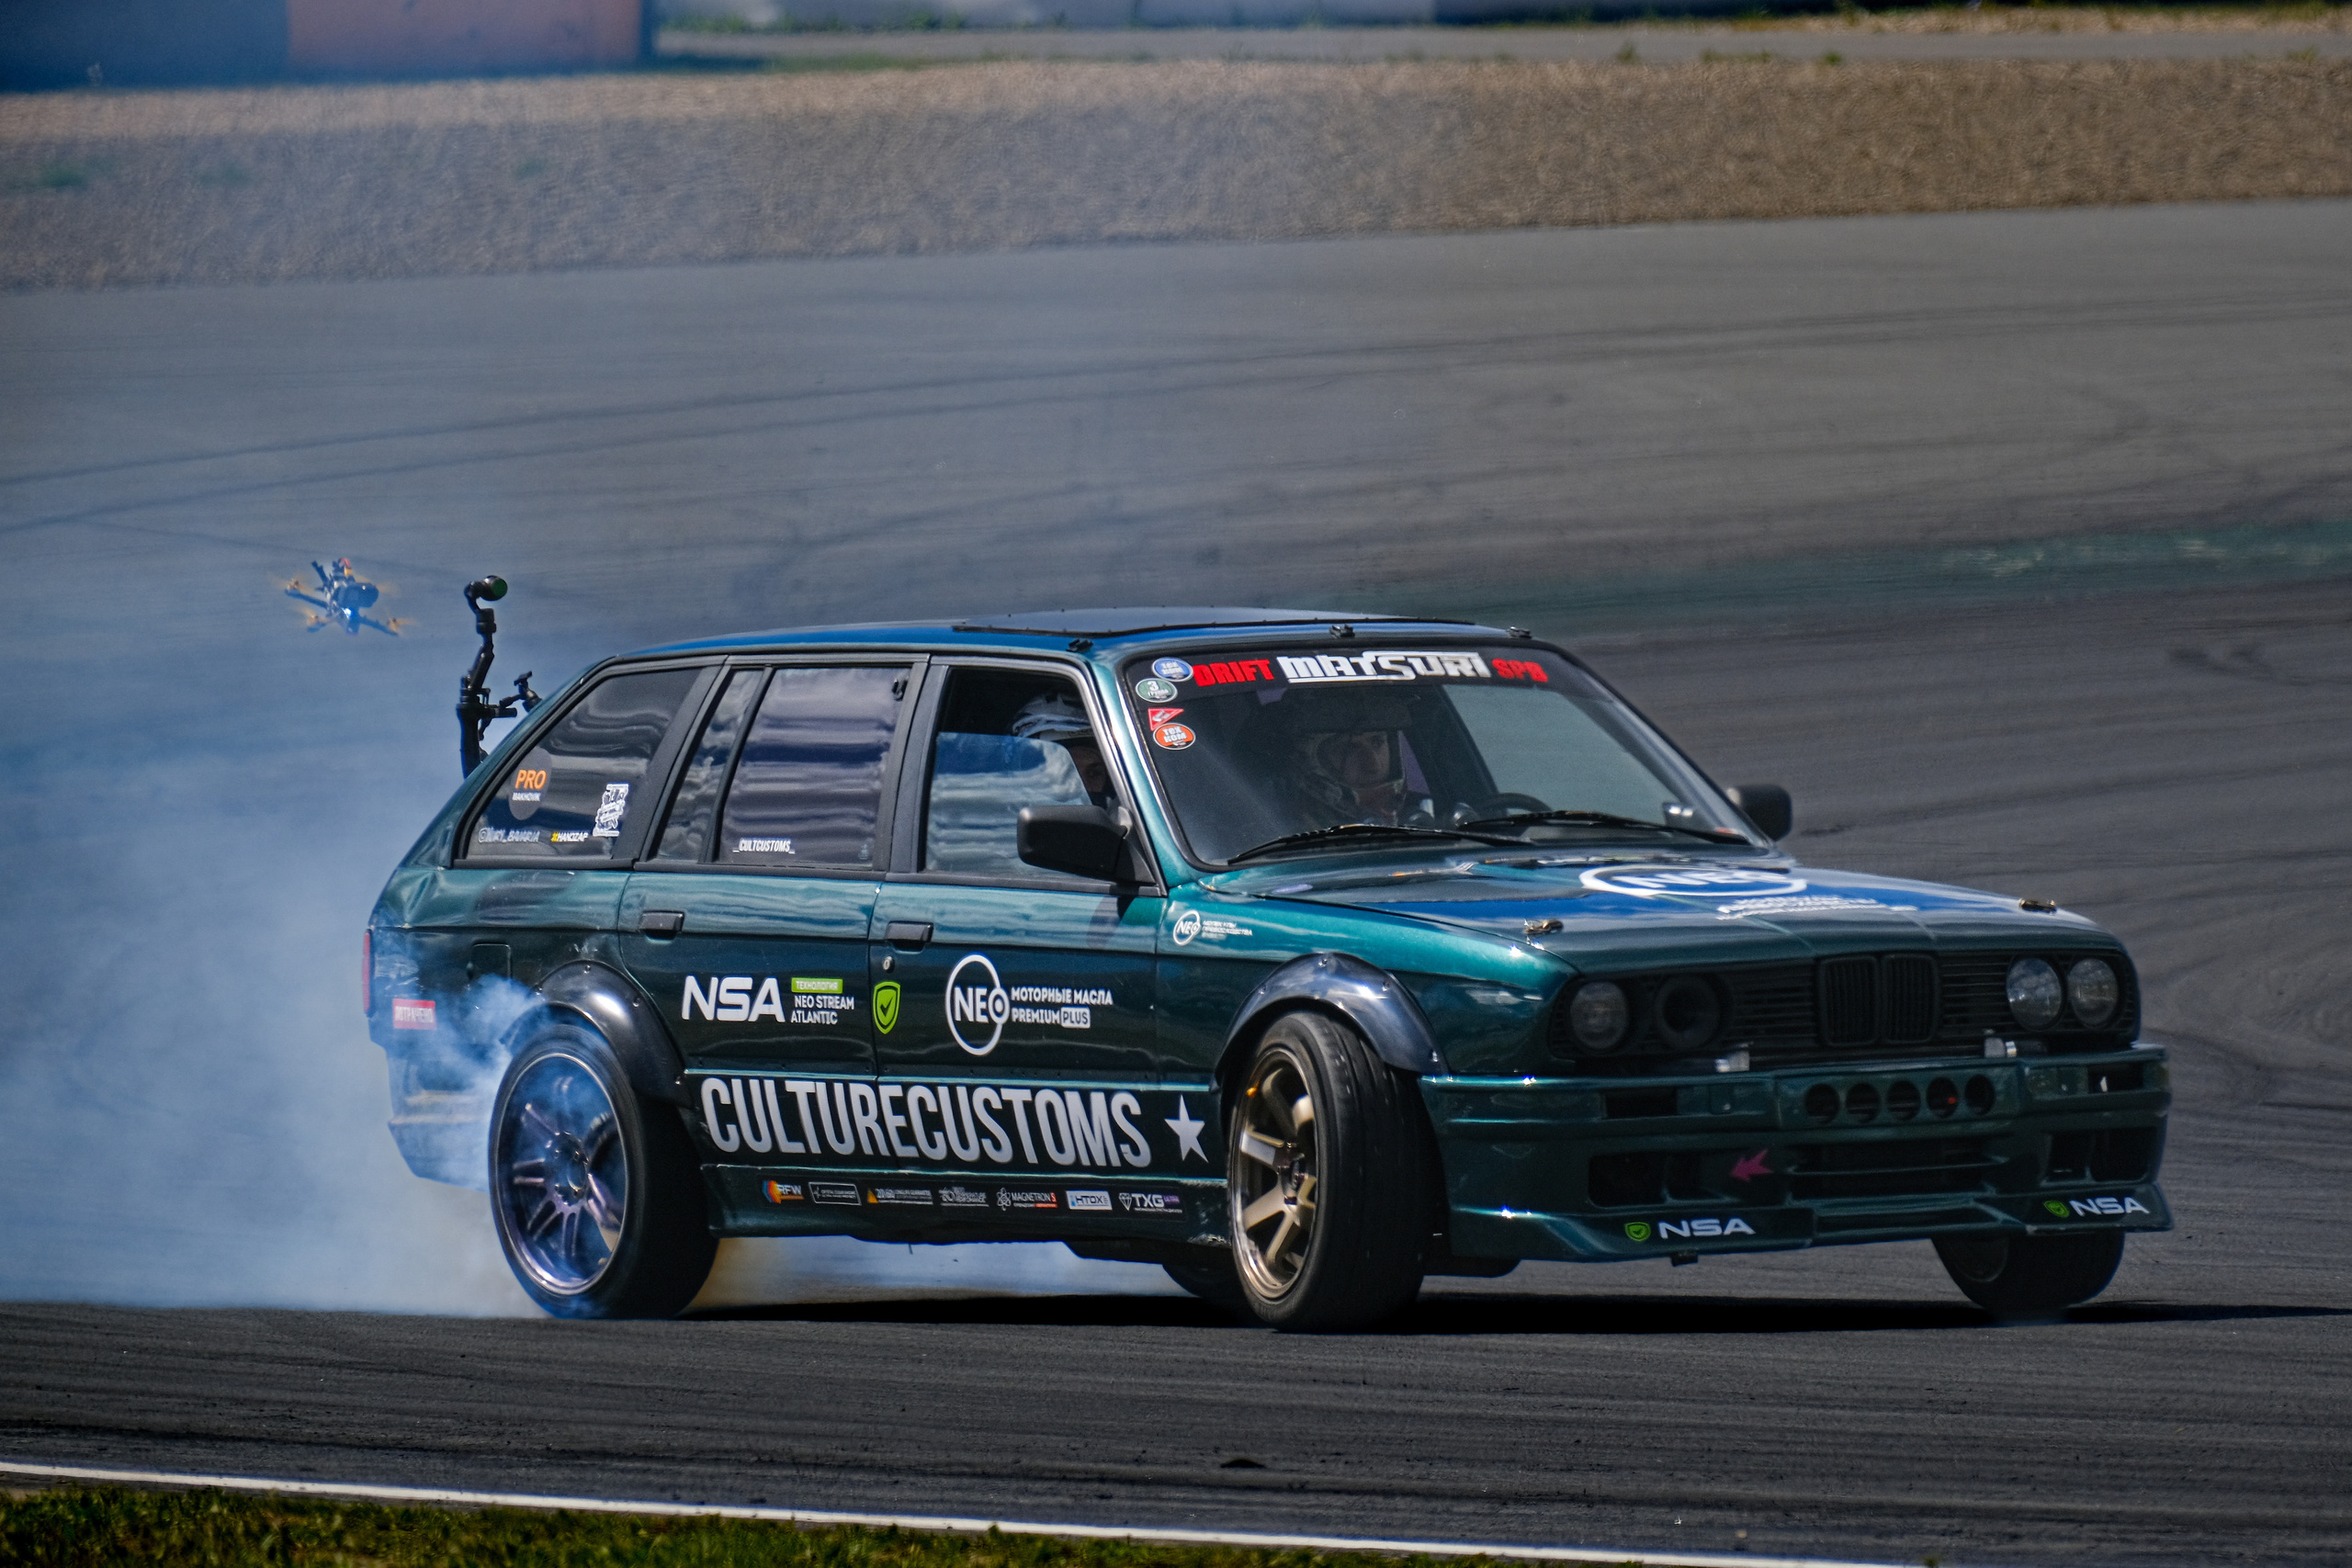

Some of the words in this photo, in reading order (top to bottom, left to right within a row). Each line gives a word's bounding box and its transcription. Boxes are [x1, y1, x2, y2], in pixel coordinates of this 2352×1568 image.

[1192, 659, 1274, 686] DRIFT
[1276, 650, 1492, 683] MATSURI
[1491, 658, 1548, 682] SPB
[515, 769, 547, 789] PRO
[1177, 920, 1202, 936] NEO
[796, 980, 839, 991] ТЕХНОЛОГИЯ
[682, 976, 786, 1022] NSA
[794, 995, 815, 1009] NEO
[815, 995, 854, 1010] STREAM
[954, 986, 1010, 1025] NEO
[1011, 987, 1072, 1004] МОТОРНЫЕ
[1073, 988, 1114, 1006] МАСЛА
[790, 1010, 838, 1025] ATLANTIC
[1012, 1007, 1060, 1024] PREMIUM
[1062, 1010, 1089, 1025] PLUS
[700, 1077, 1152, 1168] CULTURECUSTOMS
[1011, 1191, 1051, 1201] MAGNETRON
[1131, 1193, 1164, 1208] TXG
[2069, 1196, 2150, 1217] NSA
[1657, 1217, 1757, 1239] NSA
